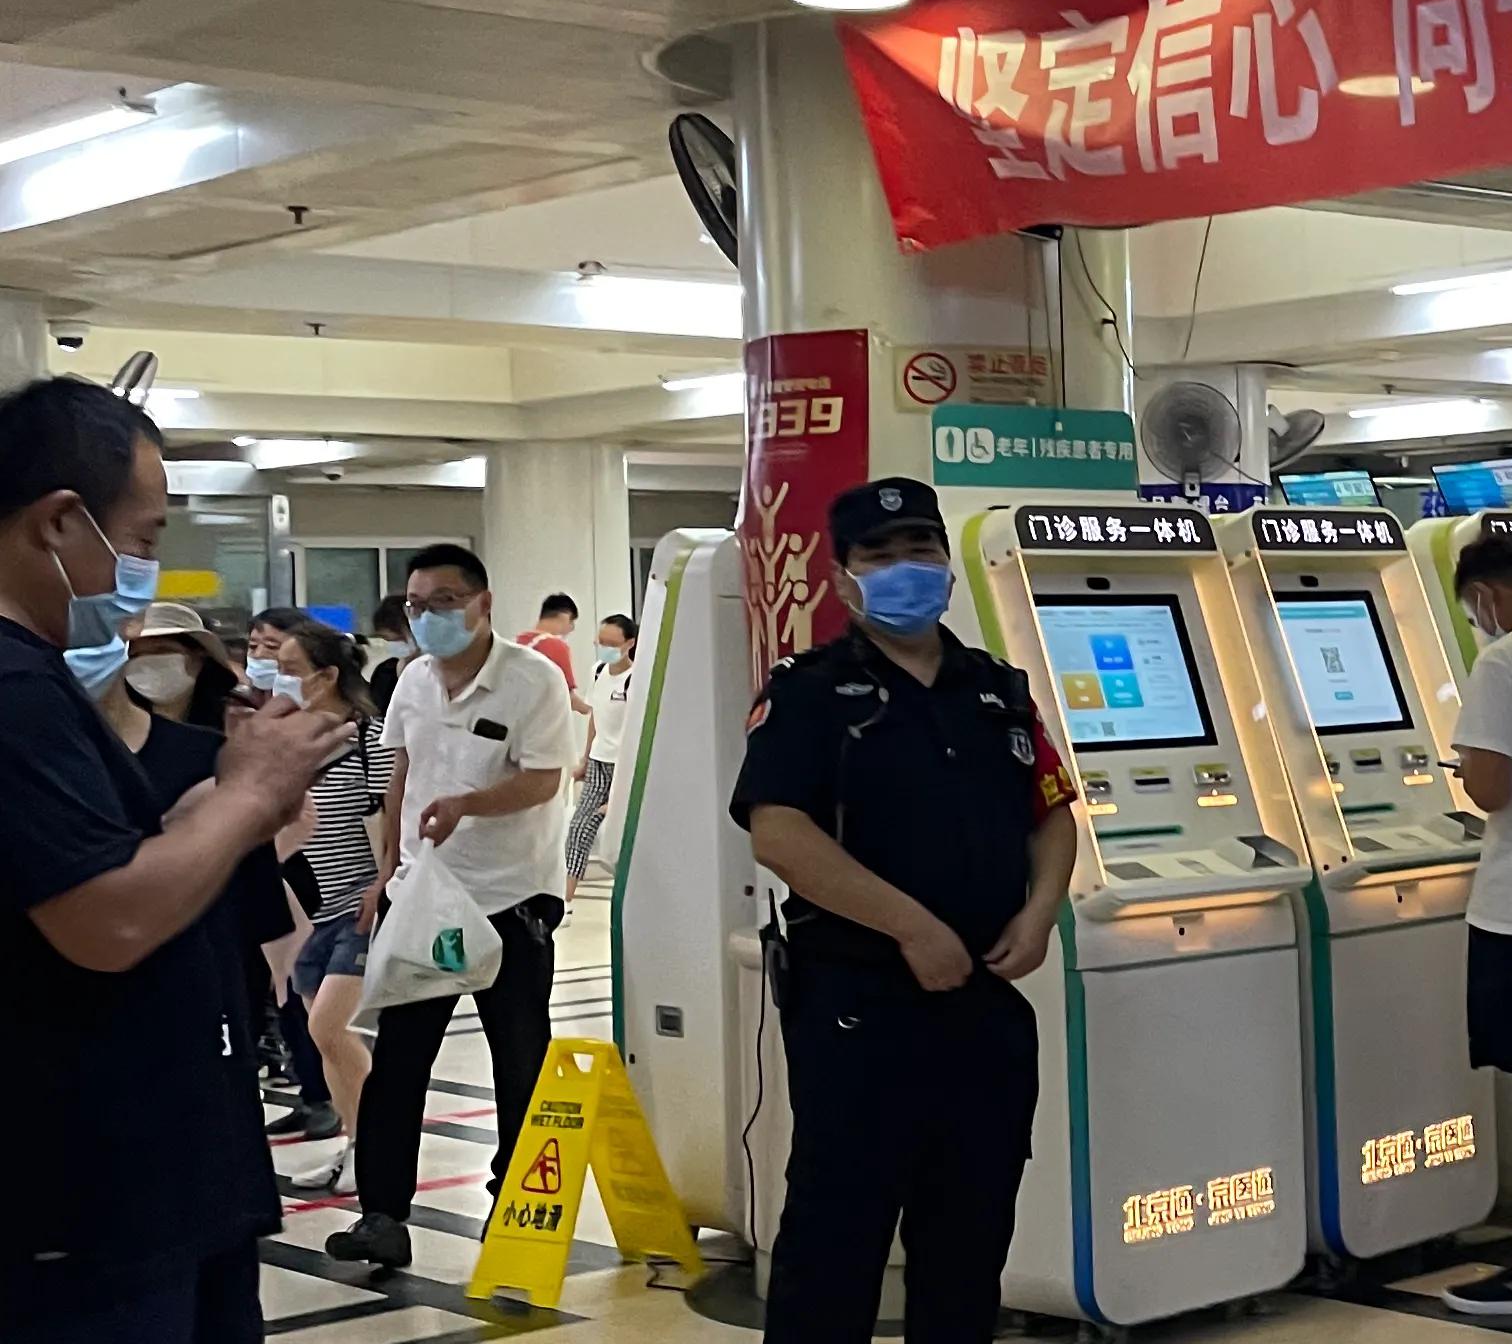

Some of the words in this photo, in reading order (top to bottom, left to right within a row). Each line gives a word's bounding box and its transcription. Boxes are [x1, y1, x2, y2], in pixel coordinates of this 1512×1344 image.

[1027, 513, 1202, 545] 门诊服务一体机
[1260, 517, 1395, 545] 门诊服务一体机
[502, 1200, 563, 1232] 小心地滑
